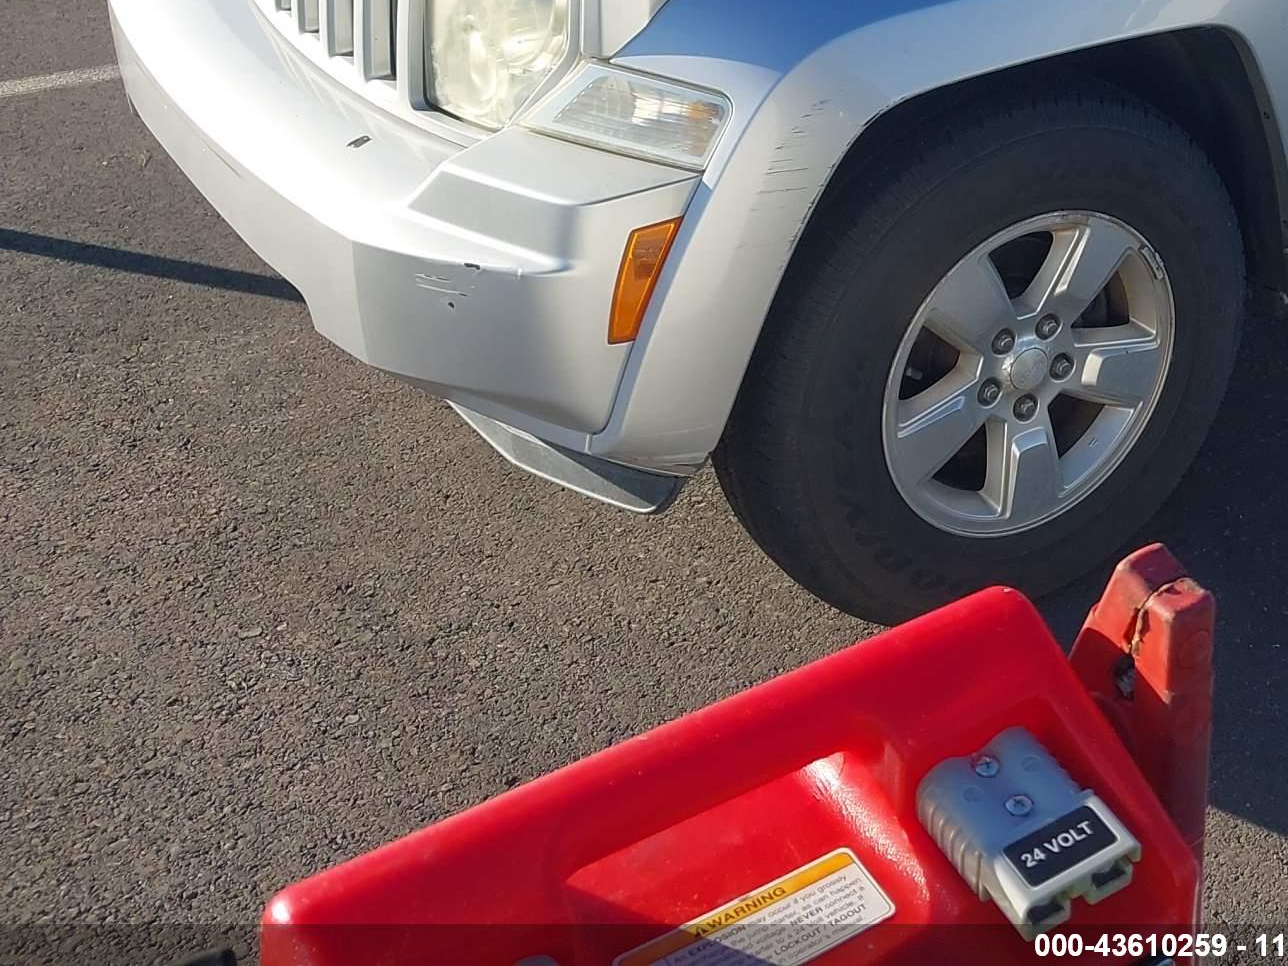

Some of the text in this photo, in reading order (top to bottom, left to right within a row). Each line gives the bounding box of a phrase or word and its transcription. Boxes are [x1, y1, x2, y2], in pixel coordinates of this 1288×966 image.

[1021, 820, 1094, 868] 24 VOLT
[828, 877, 862, 897] happen
[707, 886, 786, 929] WARNING
[789, 906, 823, 926] NEVER
[688, 924, 746, 956] EXPLOSION
[773, 927, 821, 955] LOCKOUT
[827, 903, 867, 926] TAGOUT
